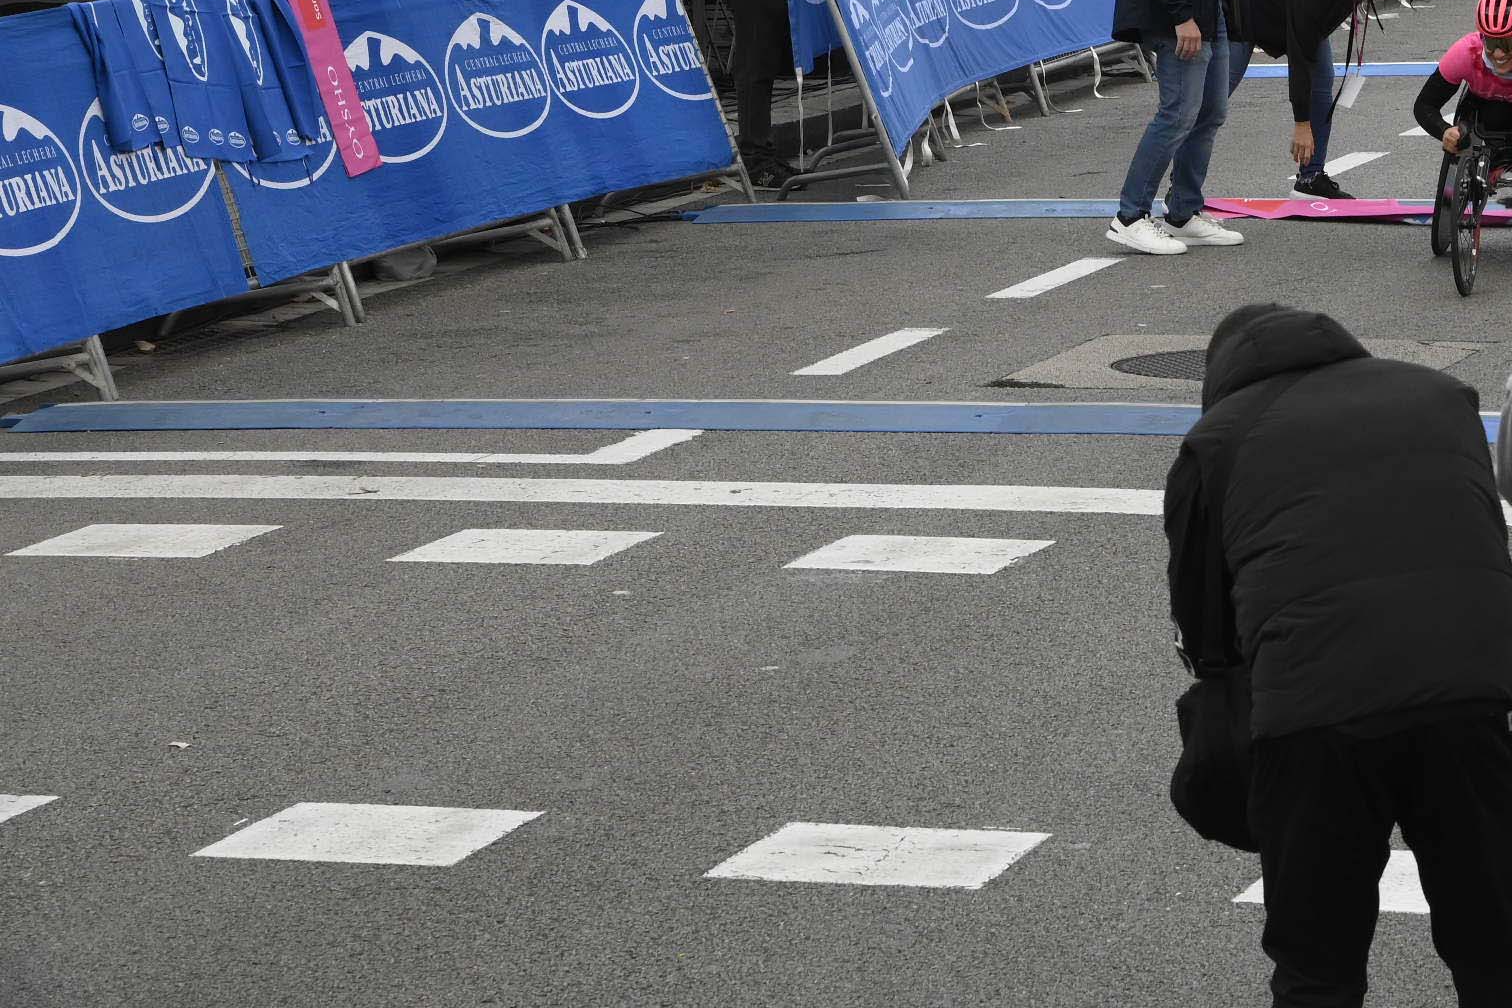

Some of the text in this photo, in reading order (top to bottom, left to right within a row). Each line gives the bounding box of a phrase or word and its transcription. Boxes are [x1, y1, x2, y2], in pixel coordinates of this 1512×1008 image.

[464, 49, 532, 72] CENTRAL LECHERA
[558, 36, 618, 56] CENTRAL LECHERA
[642, 31, 704, 77] ASTUR
[390, 67, 428, 87] LECHERA
[455, 63, 547, 112] ASTURIANA
[549, 47, 636, 94] ASTURIANA
[327, 65, 364, 159] OYSHO
[361, 86, 443, 133] STURIANA
[17, 145, 57, 163] LECHERA
